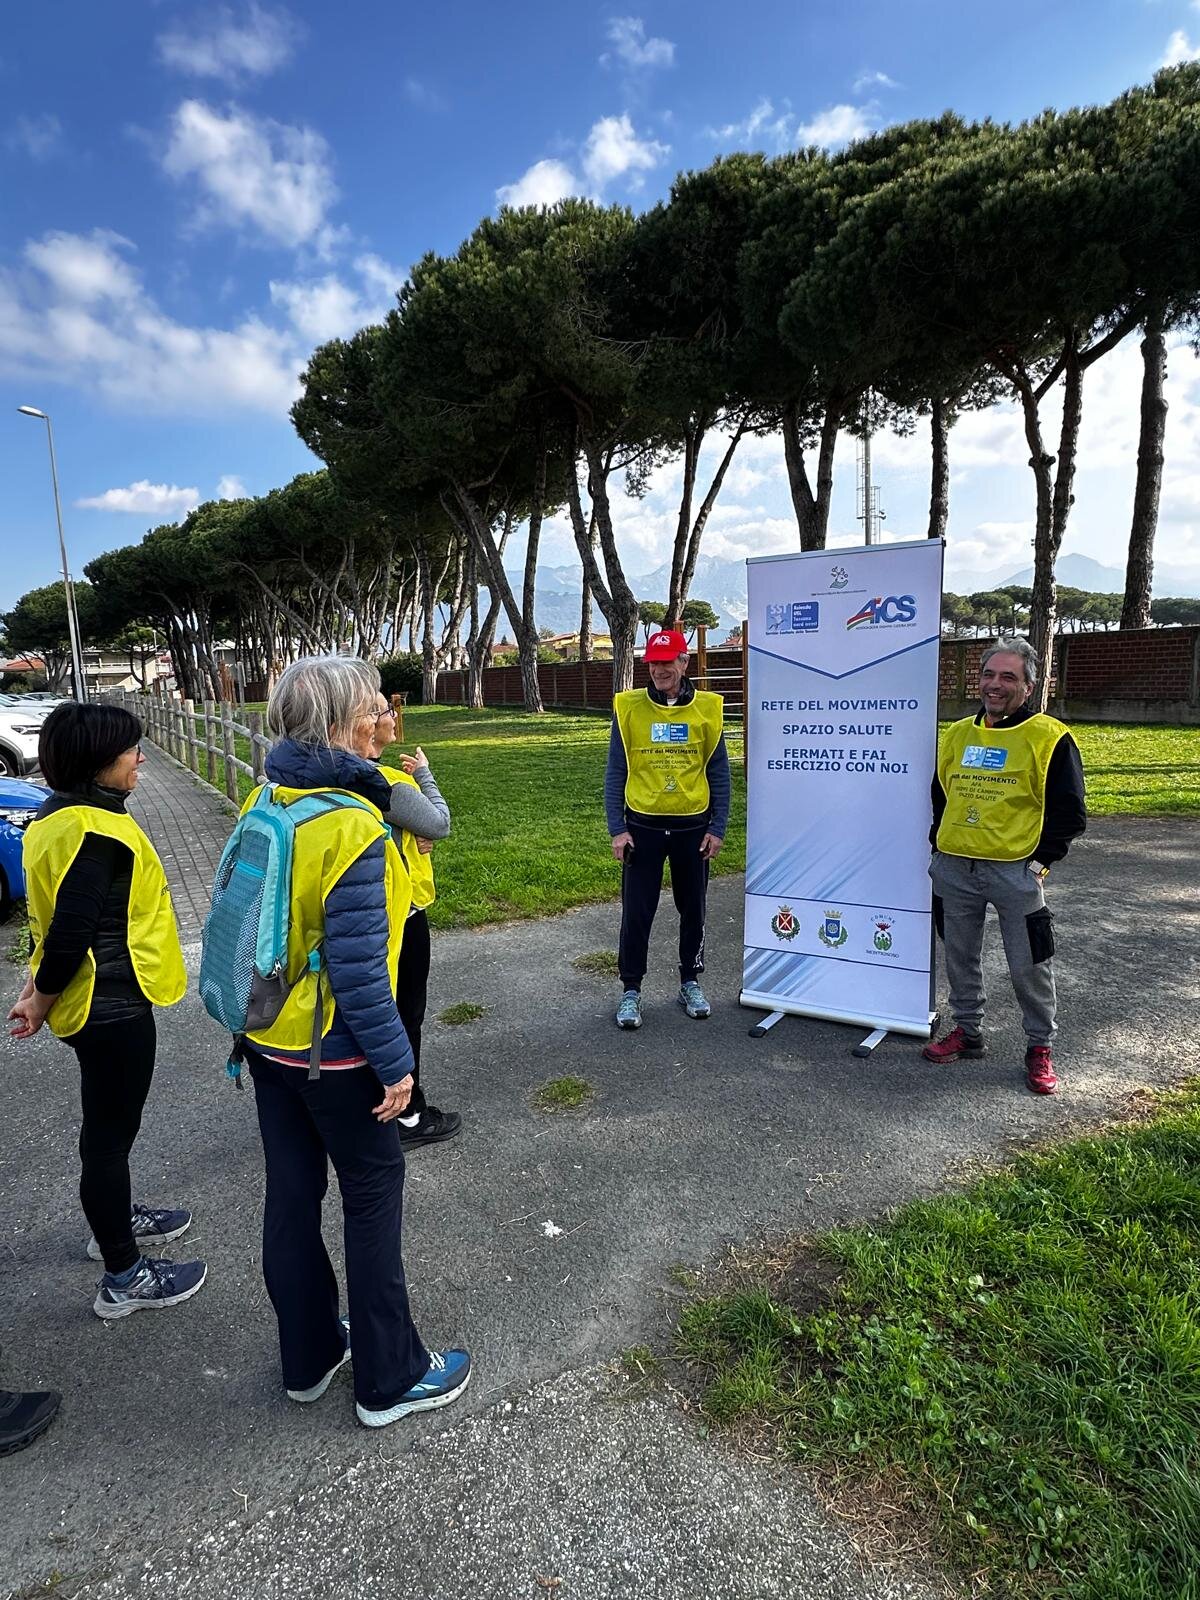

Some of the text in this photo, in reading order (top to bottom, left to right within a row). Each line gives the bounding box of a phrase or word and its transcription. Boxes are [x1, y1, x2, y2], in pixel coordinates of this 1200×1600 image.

[761, 699, 919, 711] RETE DEL MOVIMENTO
[782, 724, 893, 735] SPAZIO SALUTE
[784, 748, 887, 761] FERMATI E FAI
[767, 760, 909, 774] ESERCIZIO CON NOI
[973, 775, 1017, 785] MOVIMENTO
